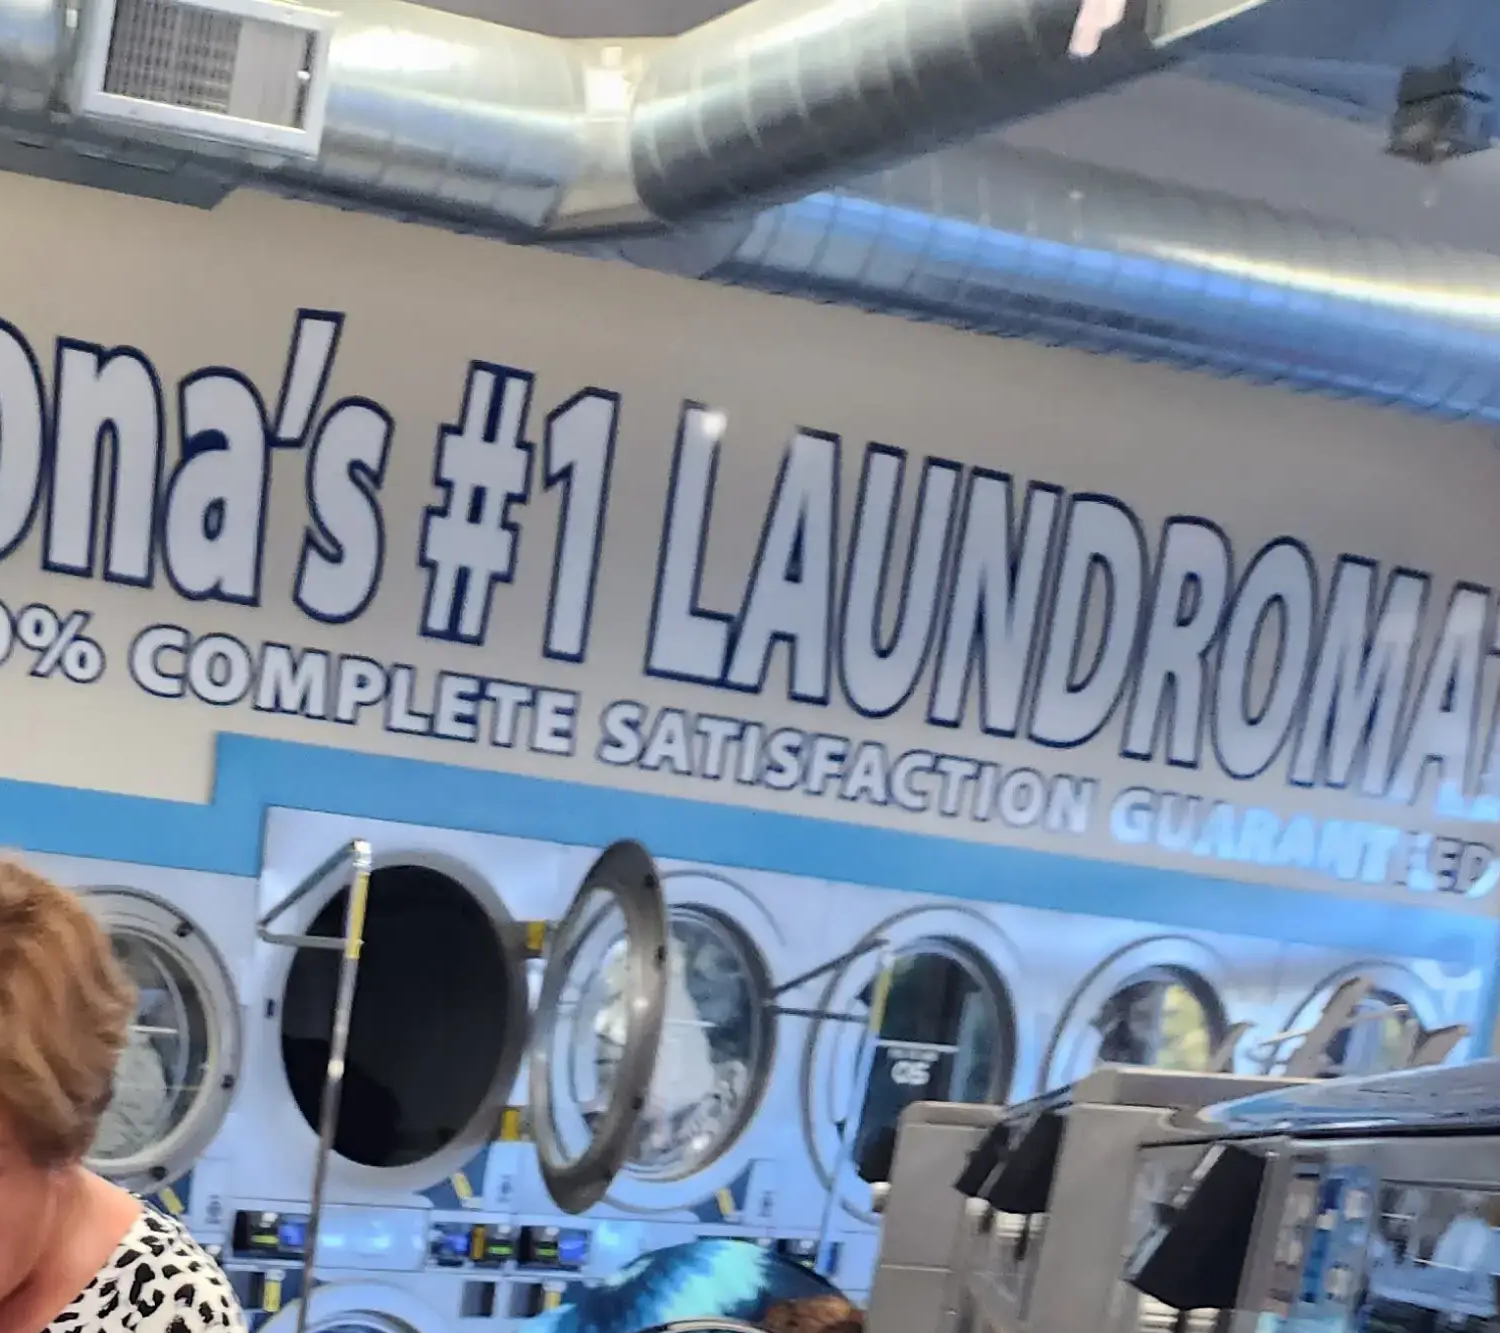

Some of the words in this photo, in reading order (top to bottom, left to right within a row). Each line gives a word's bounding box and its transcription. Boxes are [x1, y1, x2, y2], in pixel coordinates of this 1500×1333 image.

[128, 623, 581, 757] COMPLETE
[597, 699, 1100, 834] SATISFACTION
[420, 358, 621, 664] #1
[644, 398, 1500, 823] LAUNDROMA
